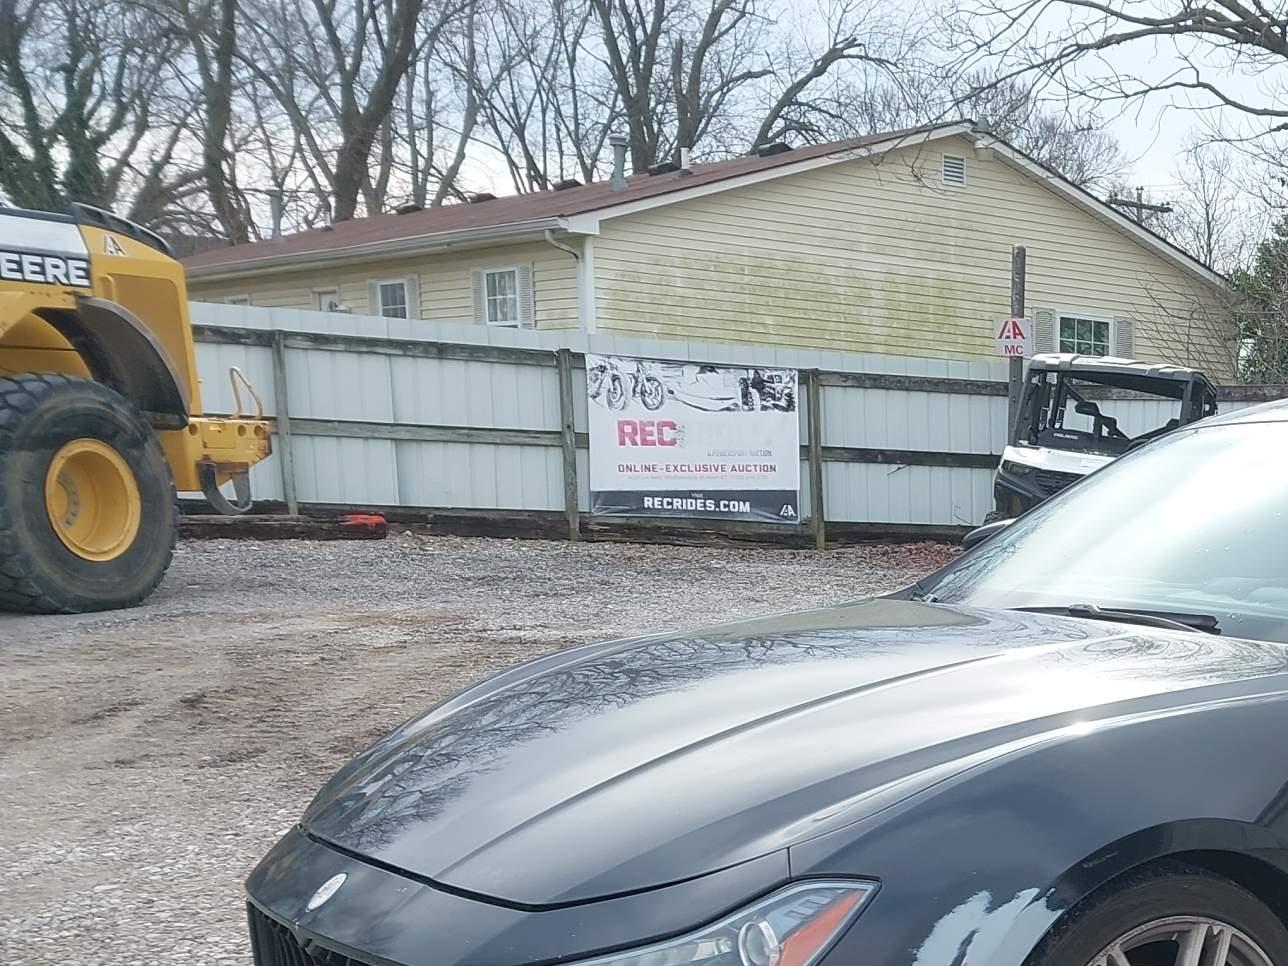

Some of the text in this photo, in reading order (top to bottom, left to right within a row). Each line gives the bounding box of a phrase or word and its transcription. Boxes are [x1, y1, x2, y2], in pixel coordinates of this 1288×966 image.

[1004, 345, 1024, 355] MC
[617, 420, 677, 446] REC
[617, 463, 777, 473] ONLINE-EXCLUSIVE AUCTION
[644, 497, 750, 512] RECRIDES.COM
